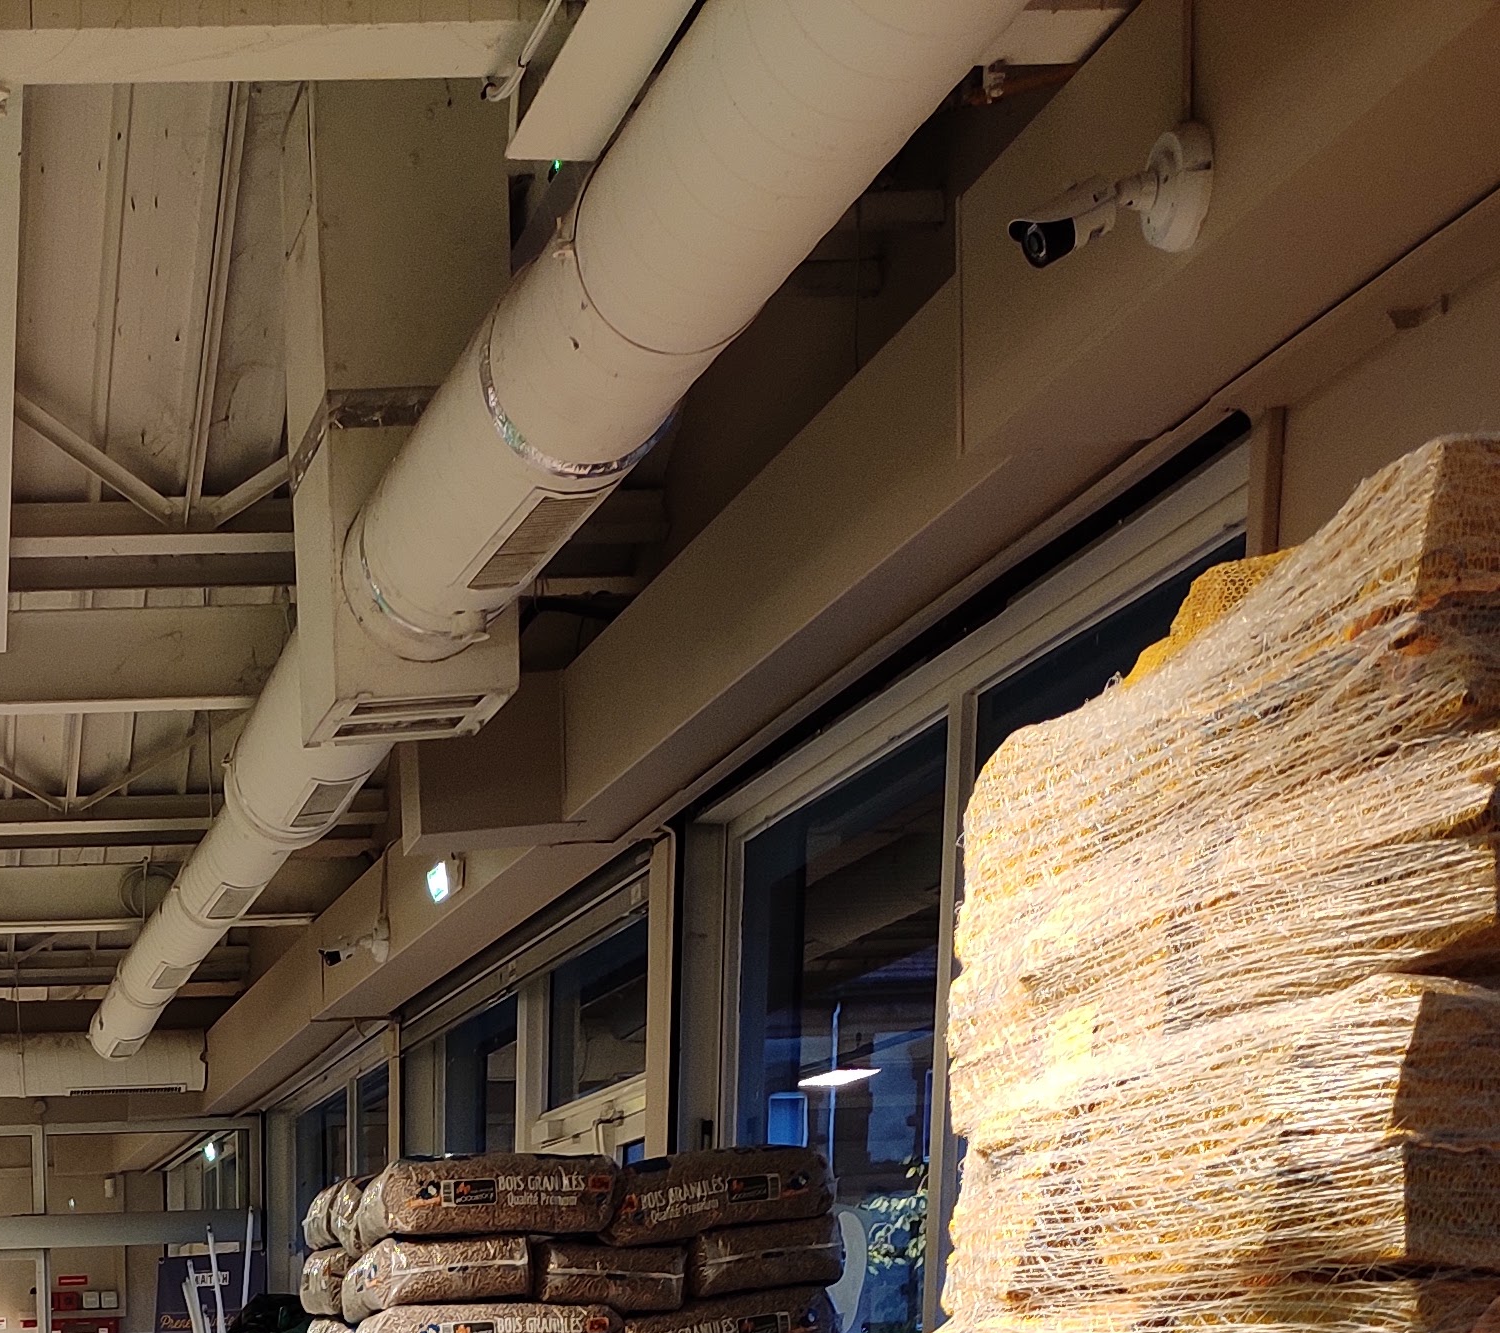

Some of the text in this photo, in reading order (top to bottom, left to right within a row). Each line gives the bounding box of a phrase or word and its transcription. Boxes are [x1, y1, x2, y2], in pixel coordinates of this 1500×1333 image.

[498, 1171, 586, 1192] BOIS GRANULÉS
[508, 1192, 538, 1207] Qualité
[640, 1176, 726, 1211] BOIS GRANULÉS
[160, 1314, 192, 1329] Prene
[497, 1315, 584, 1333] BOIS GRANULÉS
